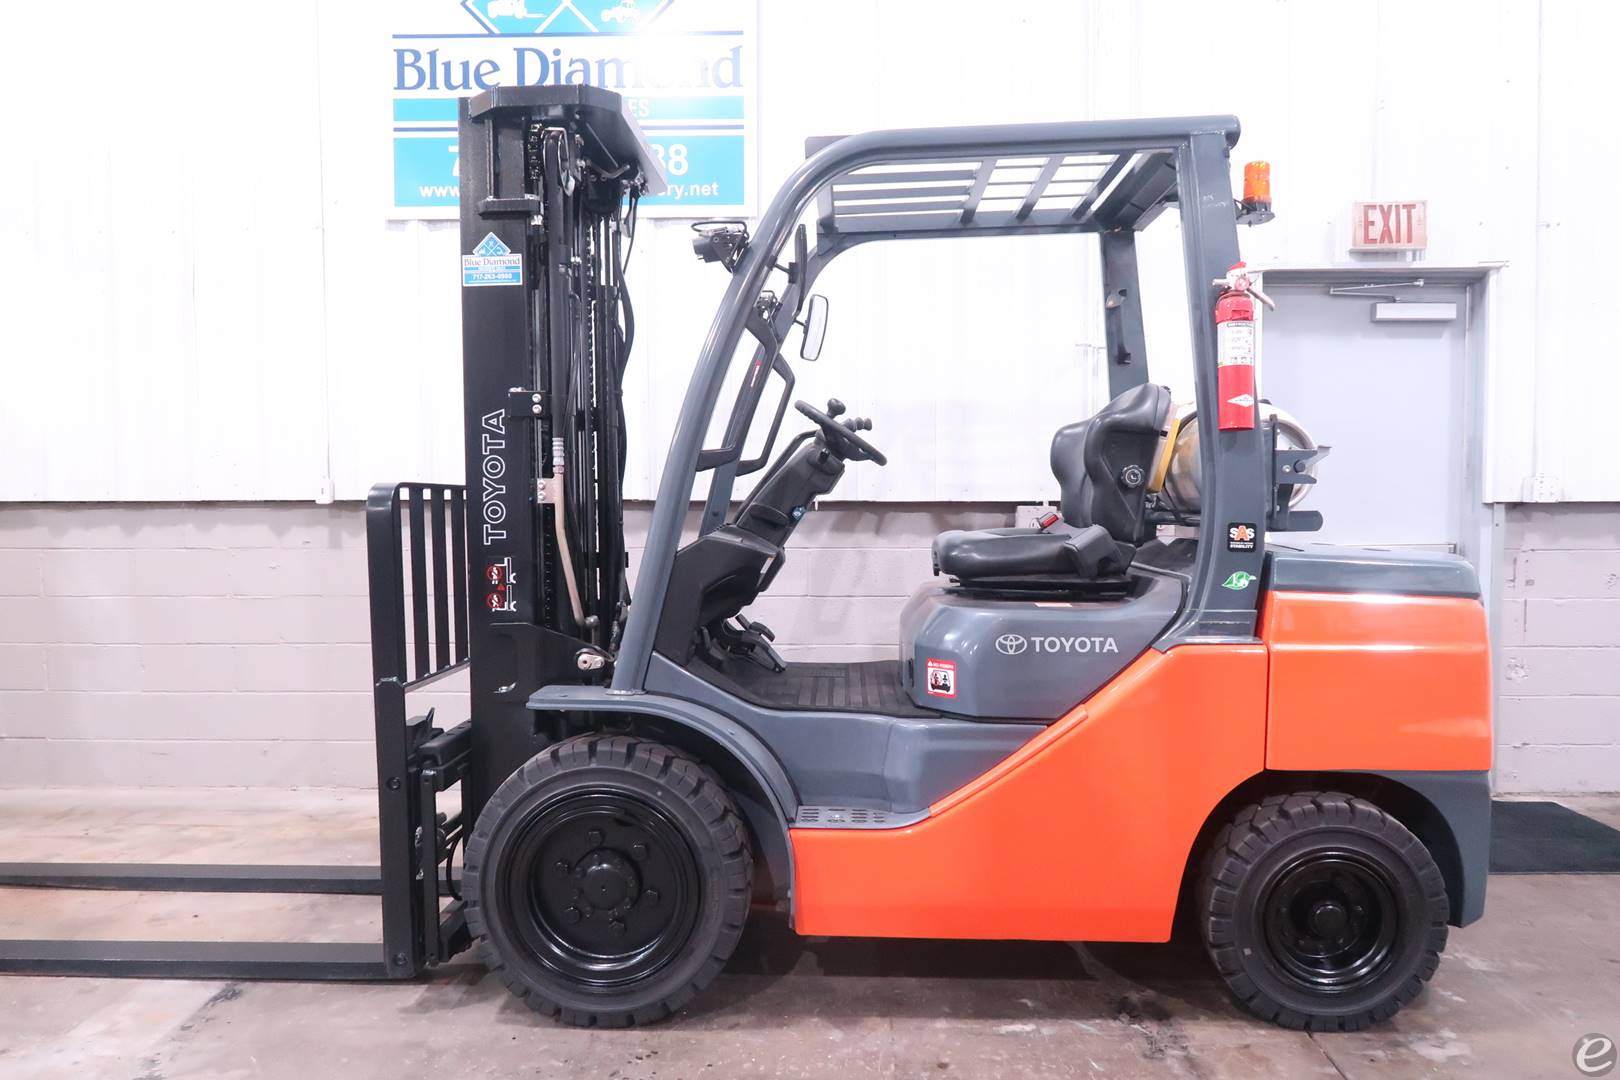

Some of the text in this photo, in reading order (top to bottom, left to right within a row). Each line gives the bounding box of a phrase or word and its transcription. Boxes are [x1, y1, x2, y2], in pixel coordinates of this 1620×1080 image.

[393, 45, 744, 91] Blue Diamnd
[1362, 203, 1417, 245] EXIT
[464, 256, 520, 267] Blue Diamond
[482, 408, 507, 546] TOYOTA
[1229, 525, 1255, 541] SAS
[1031, 636, 1119, 653] TOYOTA
